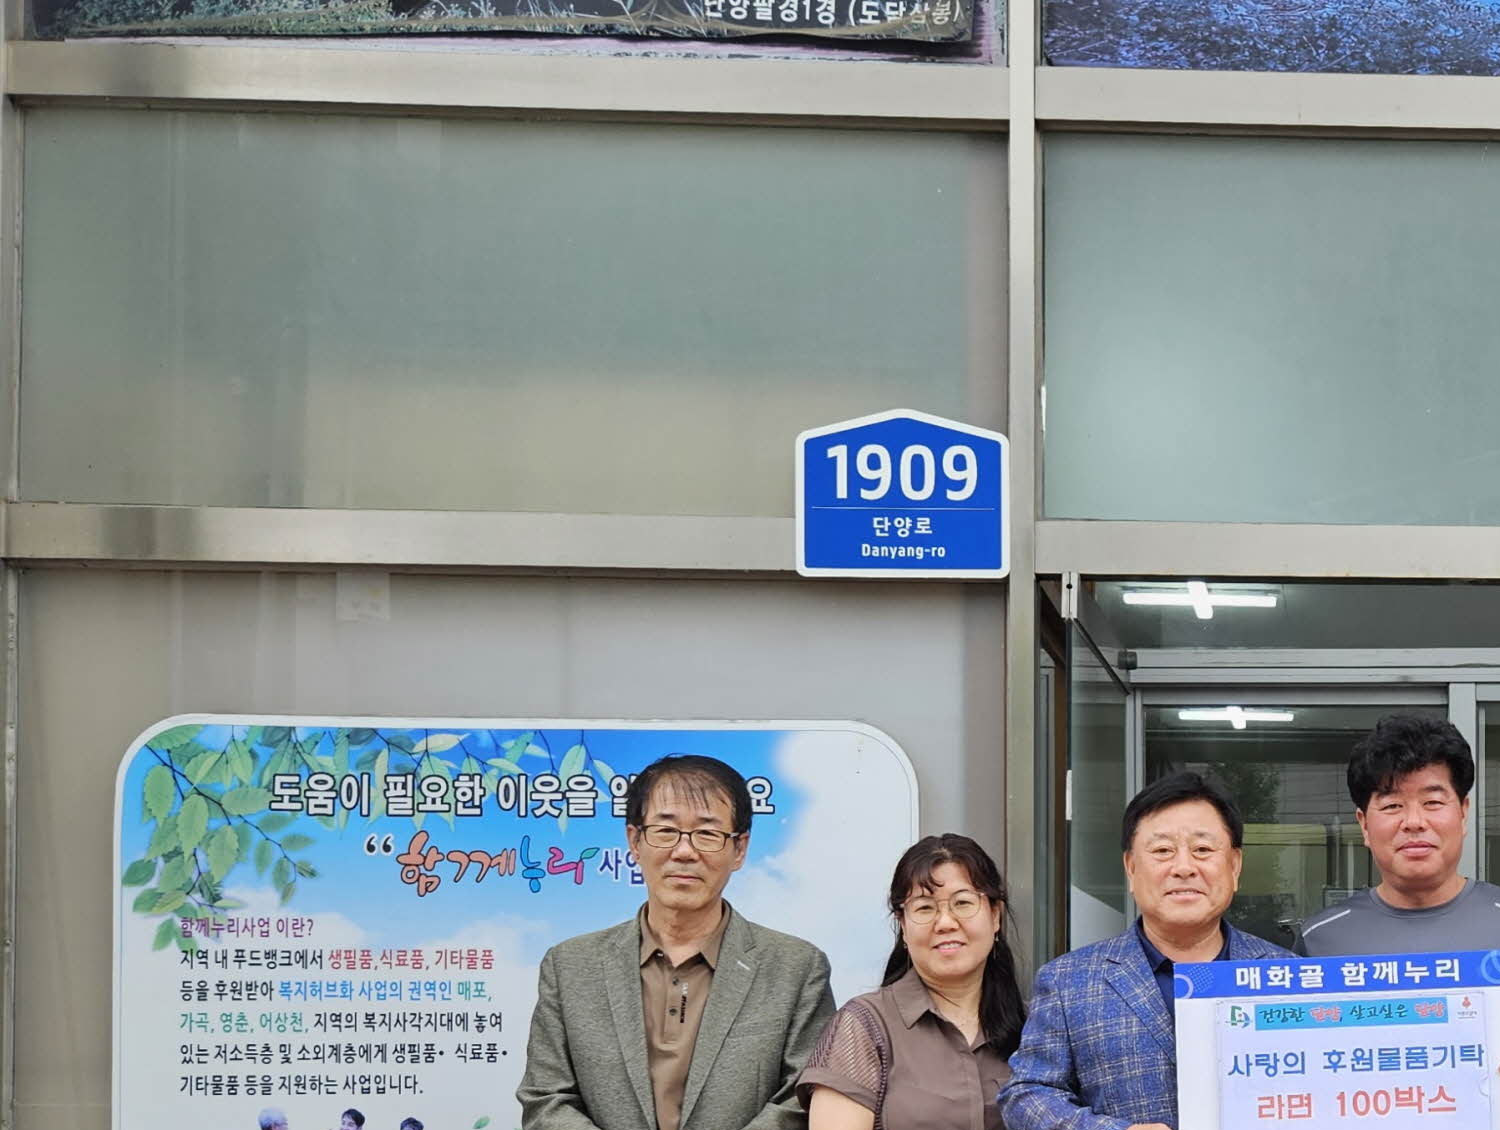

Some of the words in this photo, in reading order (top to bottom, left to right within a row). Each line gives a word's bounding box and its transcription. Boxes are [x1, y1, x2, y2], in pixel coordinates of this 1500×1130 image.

[827, 444, 978, 501] 1909
[873, 516, 933, 538] 단양로
[861, 543, 946, 559] Danyang-ro
[269, 773, 371, 818] 도움이
[383, 773, 486, 817] 필요한
[497, 773, 598, 818] 이웃을
[180, 917, 271, 938] 함께누리사업
[276, 917, 314, 938] 이란?
[180, 949, 209, 971] 지역
[214, 949, 229, 971] 내
[232, 949, 324, 971] 푸드뱅크에서
[434, 949, 495, 971] 기타물품
[1235, 963, 1325, 991] 매화골
[1341, 957, 1461, 988] 함께누리
[180, 980, 209, 1002] 등을
[214, 980, 275, 1002] 후원받아
[279, 980, 354, 1002] 복지허브화
[358, 980, 401, 1002] 사업의
[408, 980, 452, 1002] 권역인
[457, 980, 492, 1002] 매포,
[180, 1012, 215, 1034] 가곡,
[219, 1012, 255, 1034] 영춘,
[259, 1012, 309, 1034] 어상천,
[313, 1012, 358, 1034] 지역의
[362, 1012, 469, 1034] 복지사각지대에
[473, 1012, 503, 1034] 놓여
[1260, 1006, 1305, 1024] 건강한
[1349, 1003, 1408, 1021] 살고싶은
[180, 1043, 209, 1065] 있는
[214, 1043, 274, 1065] 저소득층
[279, 1043, 293, 1065] 및
[297, 1043, 388, 1065] 소외계층에게
[1228, 1051, 1307, 1078] 사랑의
[1323, 1043, 1484, 1075] 후원물품기탁
[180, 1074, 240, 1096] 기타물품
[244, 1074, 274, 1096] 등을
[278, 1074, 338, 1096] 지원하는
[342, 1074, 424, 1096] 사업입니다.
[1257, 1091, 1313, 1121] 라면
[1336, 1085, 1457, 1118] 100박스
